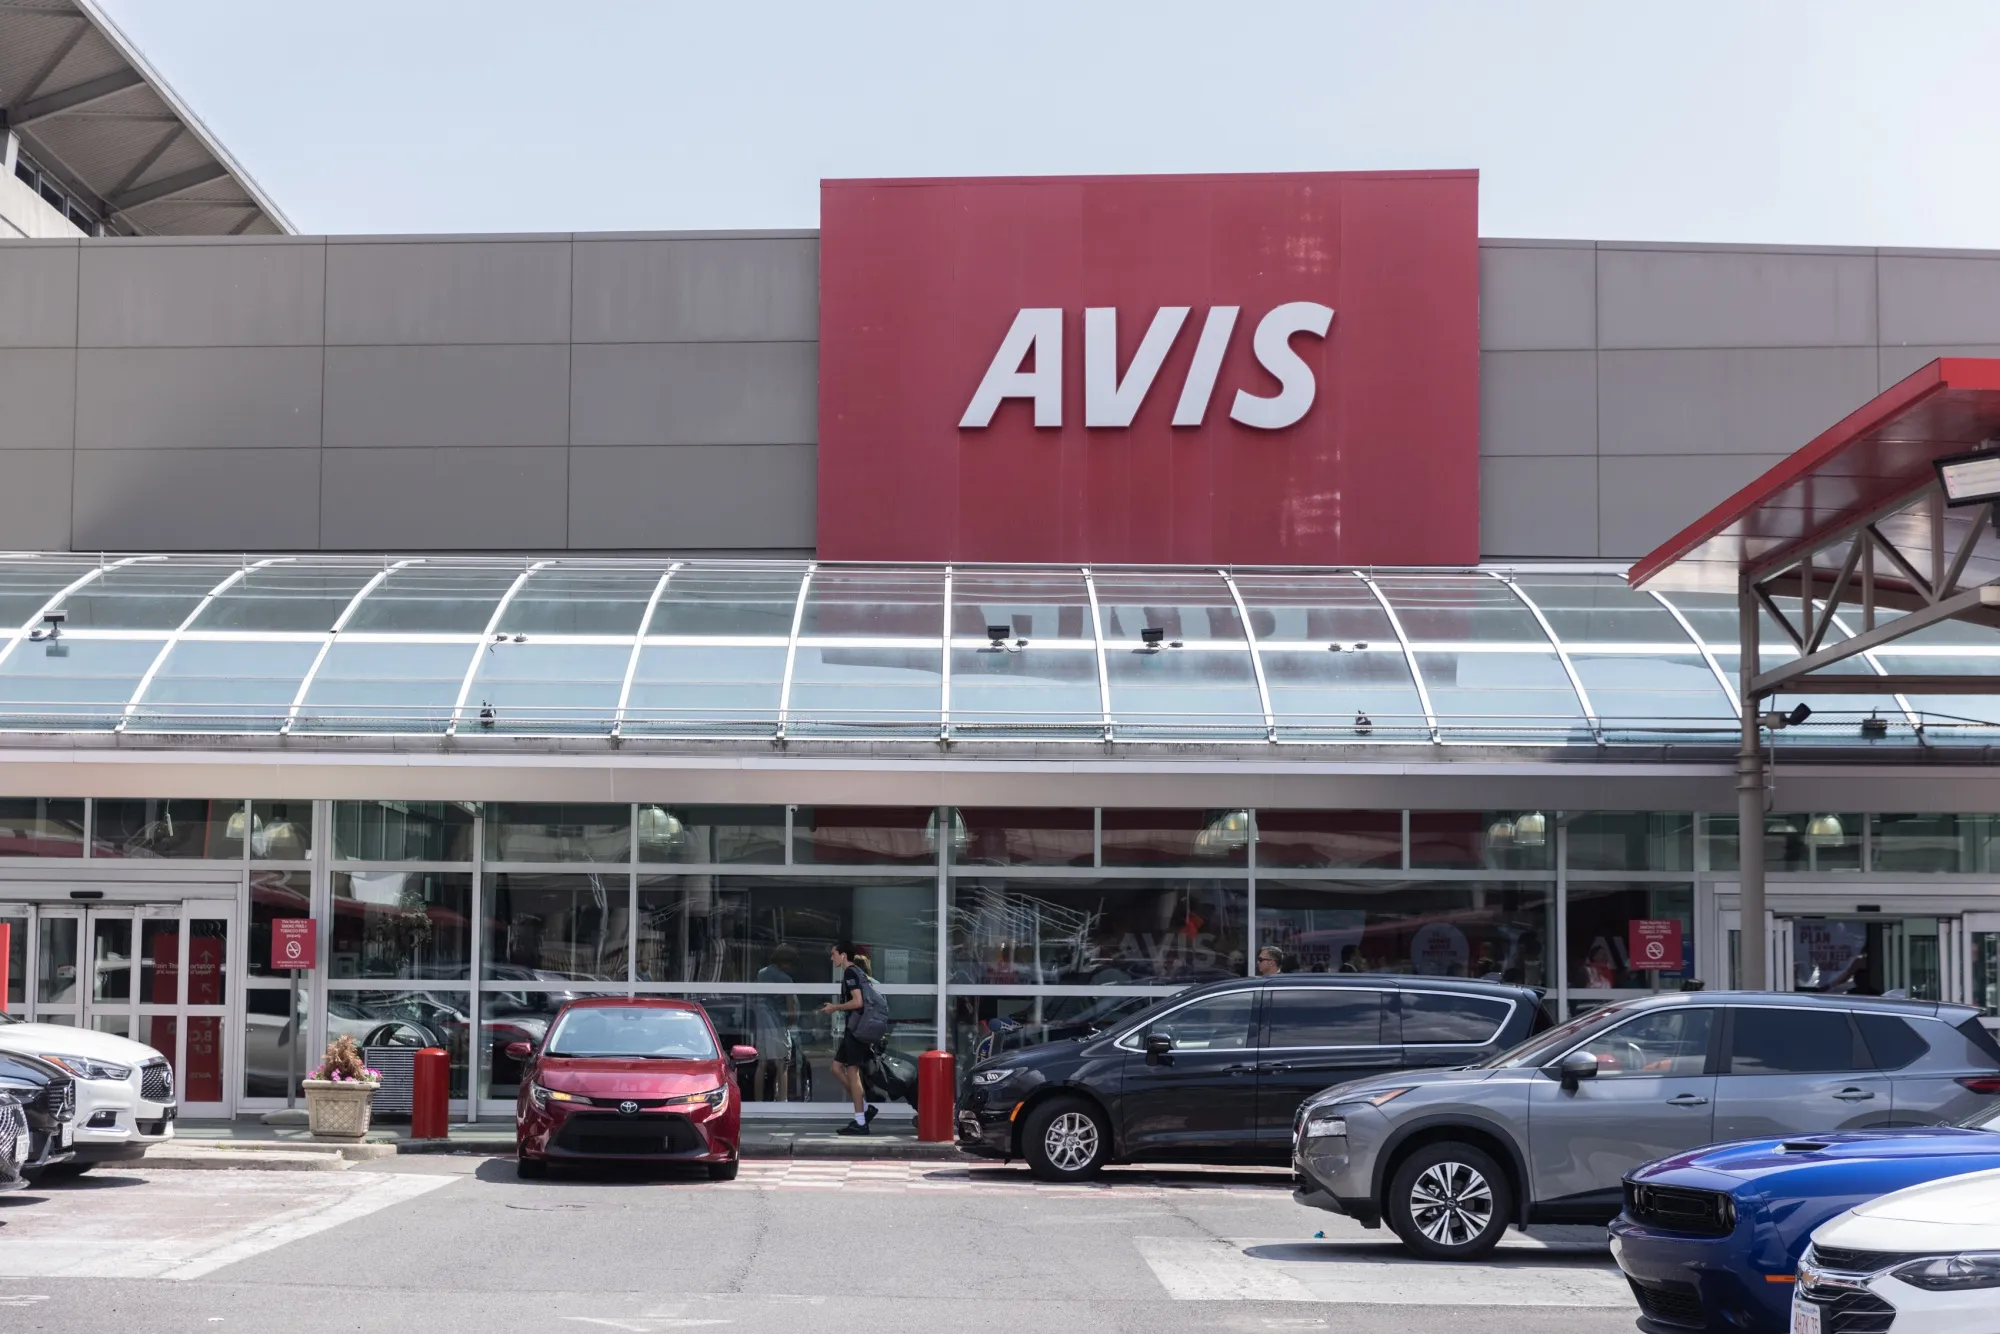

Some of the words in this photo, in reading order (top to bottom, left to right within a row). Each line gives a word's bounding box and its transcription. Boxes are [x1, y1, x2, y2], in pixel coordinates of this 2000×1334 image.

[957, 301, 1335, 430] AVIS
[1261, 927, 1302, 943] PLAN
[1800, 931, 1830, 944] PLAN
[1111, 932, 1217, 970] AVIS
